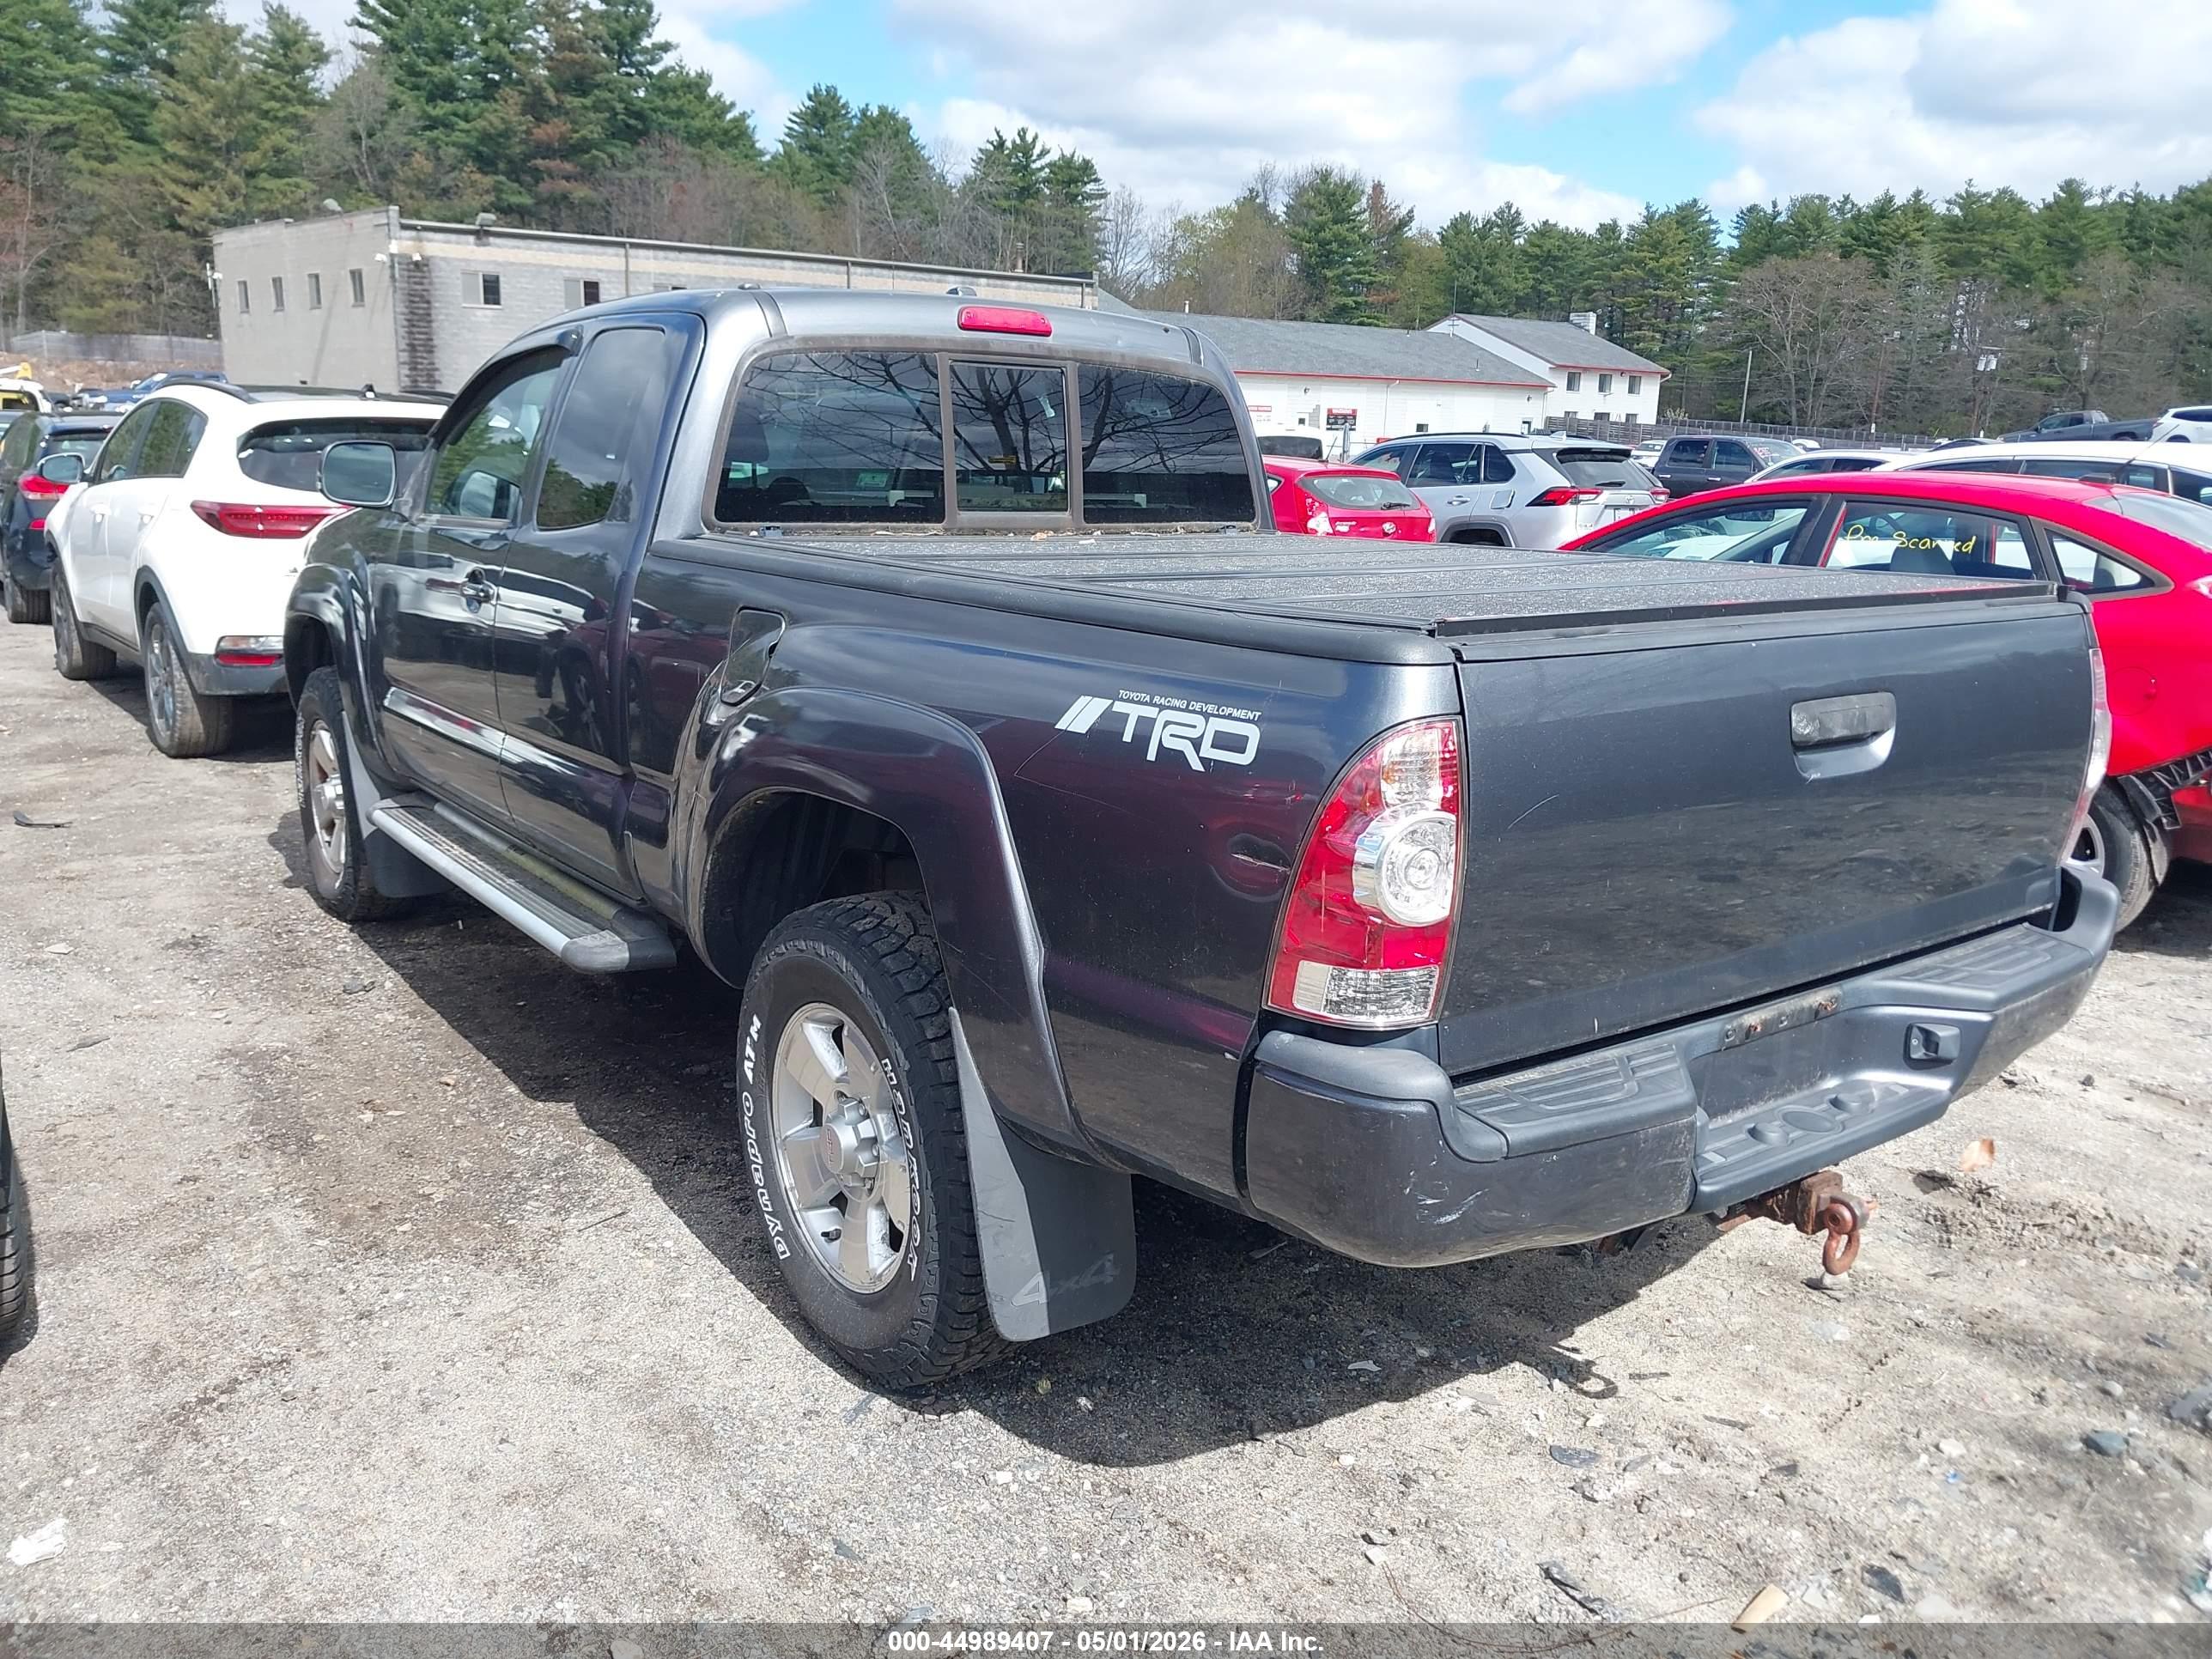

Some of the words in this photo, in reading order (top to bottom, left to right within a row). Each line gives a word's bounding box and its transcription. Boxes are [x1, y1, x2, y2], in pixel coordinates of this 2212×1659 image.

[1893, 531, 1977, 555] Scaned
[1119, 690, 1151, 703] TOYOTA
[1152, 696, 1187, 709] RACING
[1188, 701, 1261, 721] DEVELOPMENT
[1112, 700, 1261, 773] TRD
[742, 1091, 791, 1260] Dynapro
